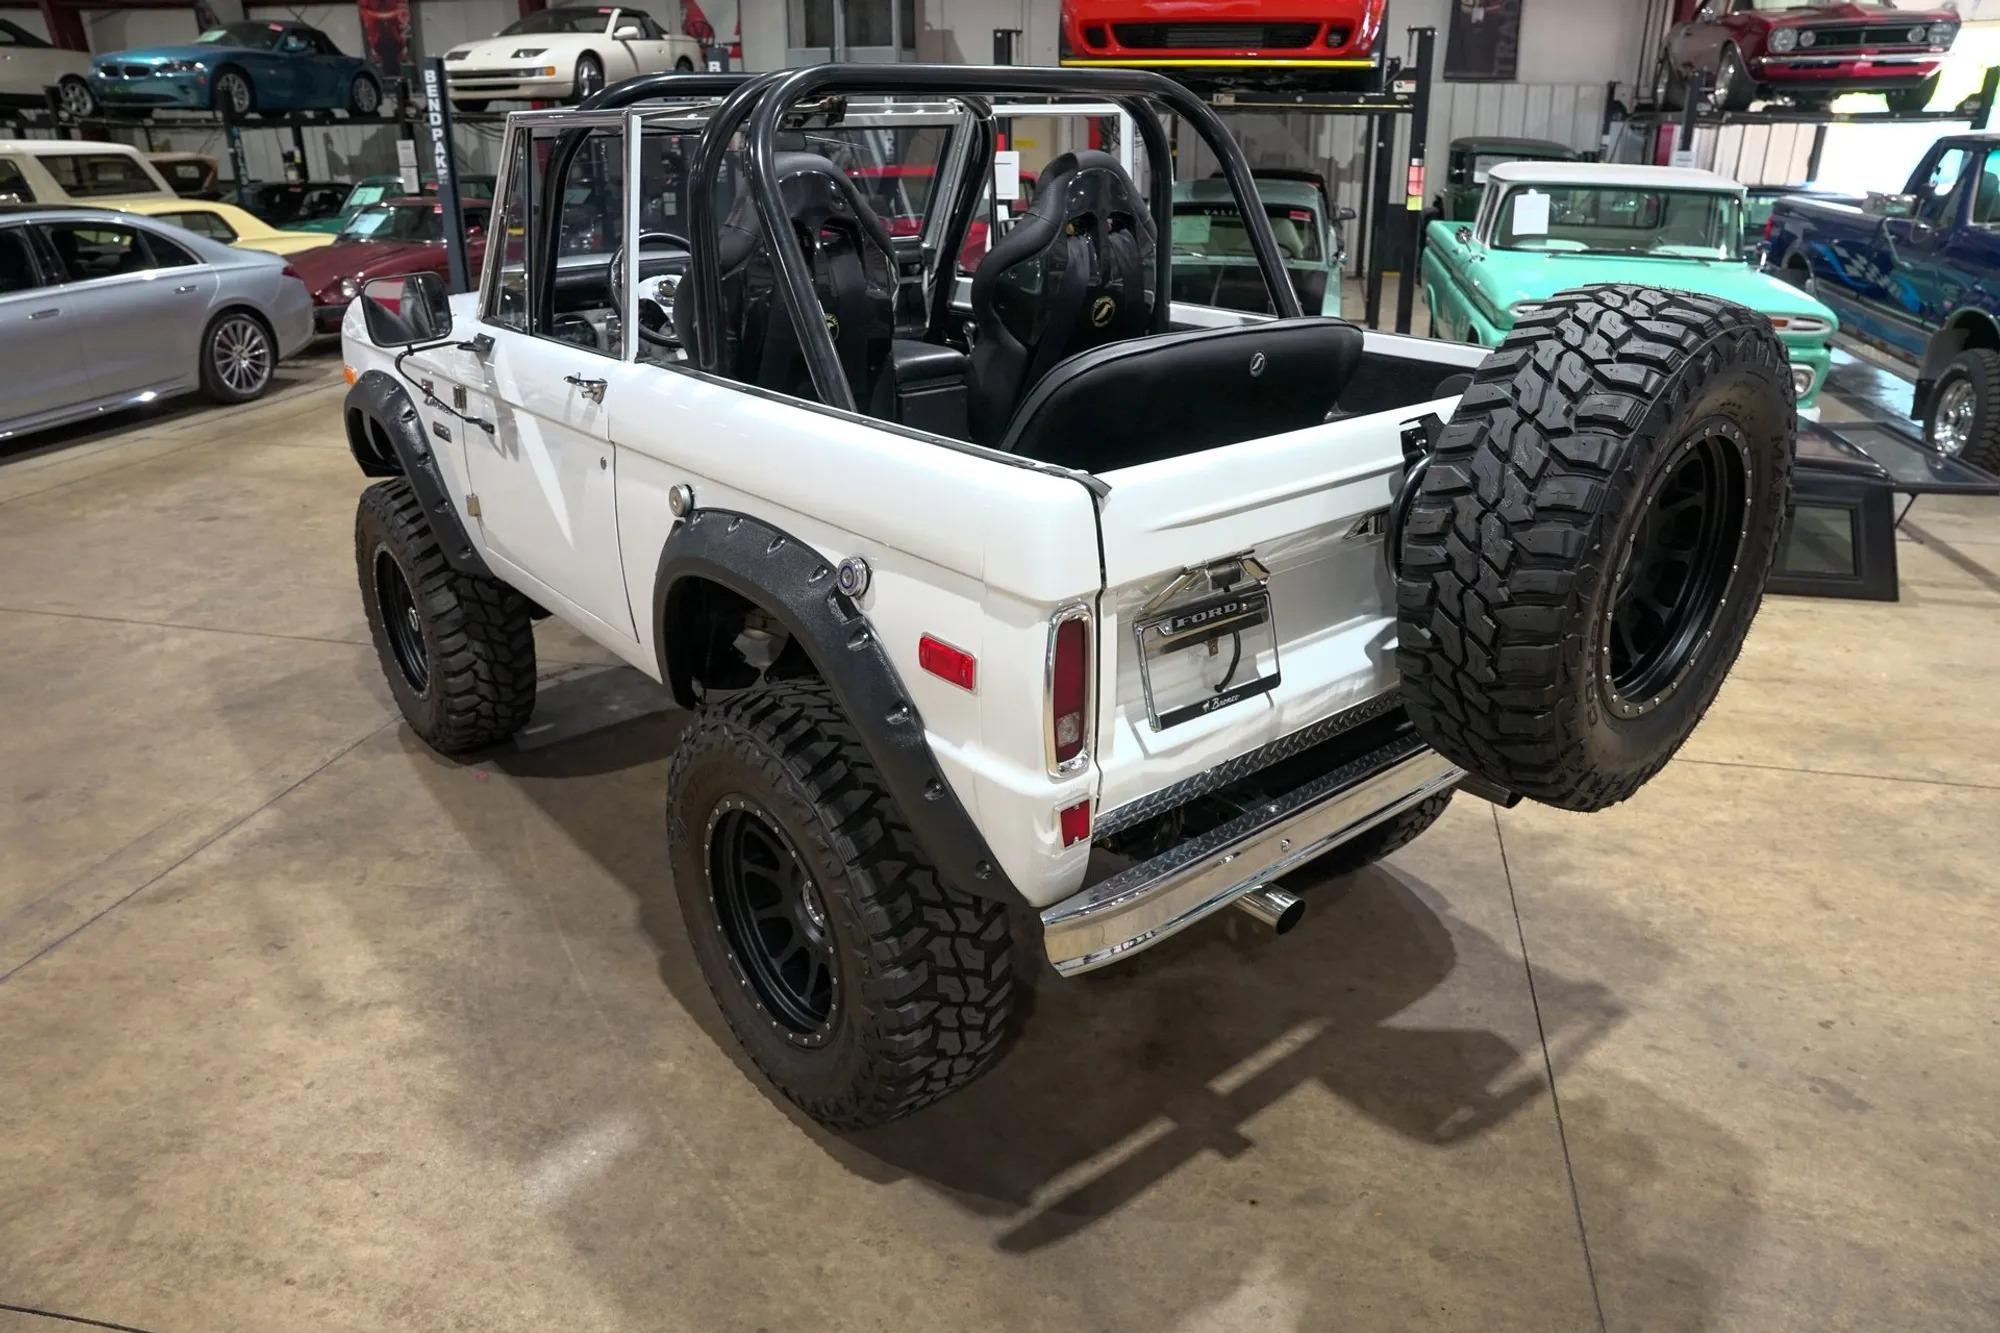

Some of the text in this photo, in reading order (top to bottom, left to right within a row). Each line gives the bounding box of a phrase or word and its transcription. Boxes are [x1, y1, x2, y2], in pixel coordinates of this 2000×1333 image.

[424, 69, 448, 169] BENDPAK
[1176, 603, 1238, 628] FORD
[1211, 694, 1241, 710] Bronco
